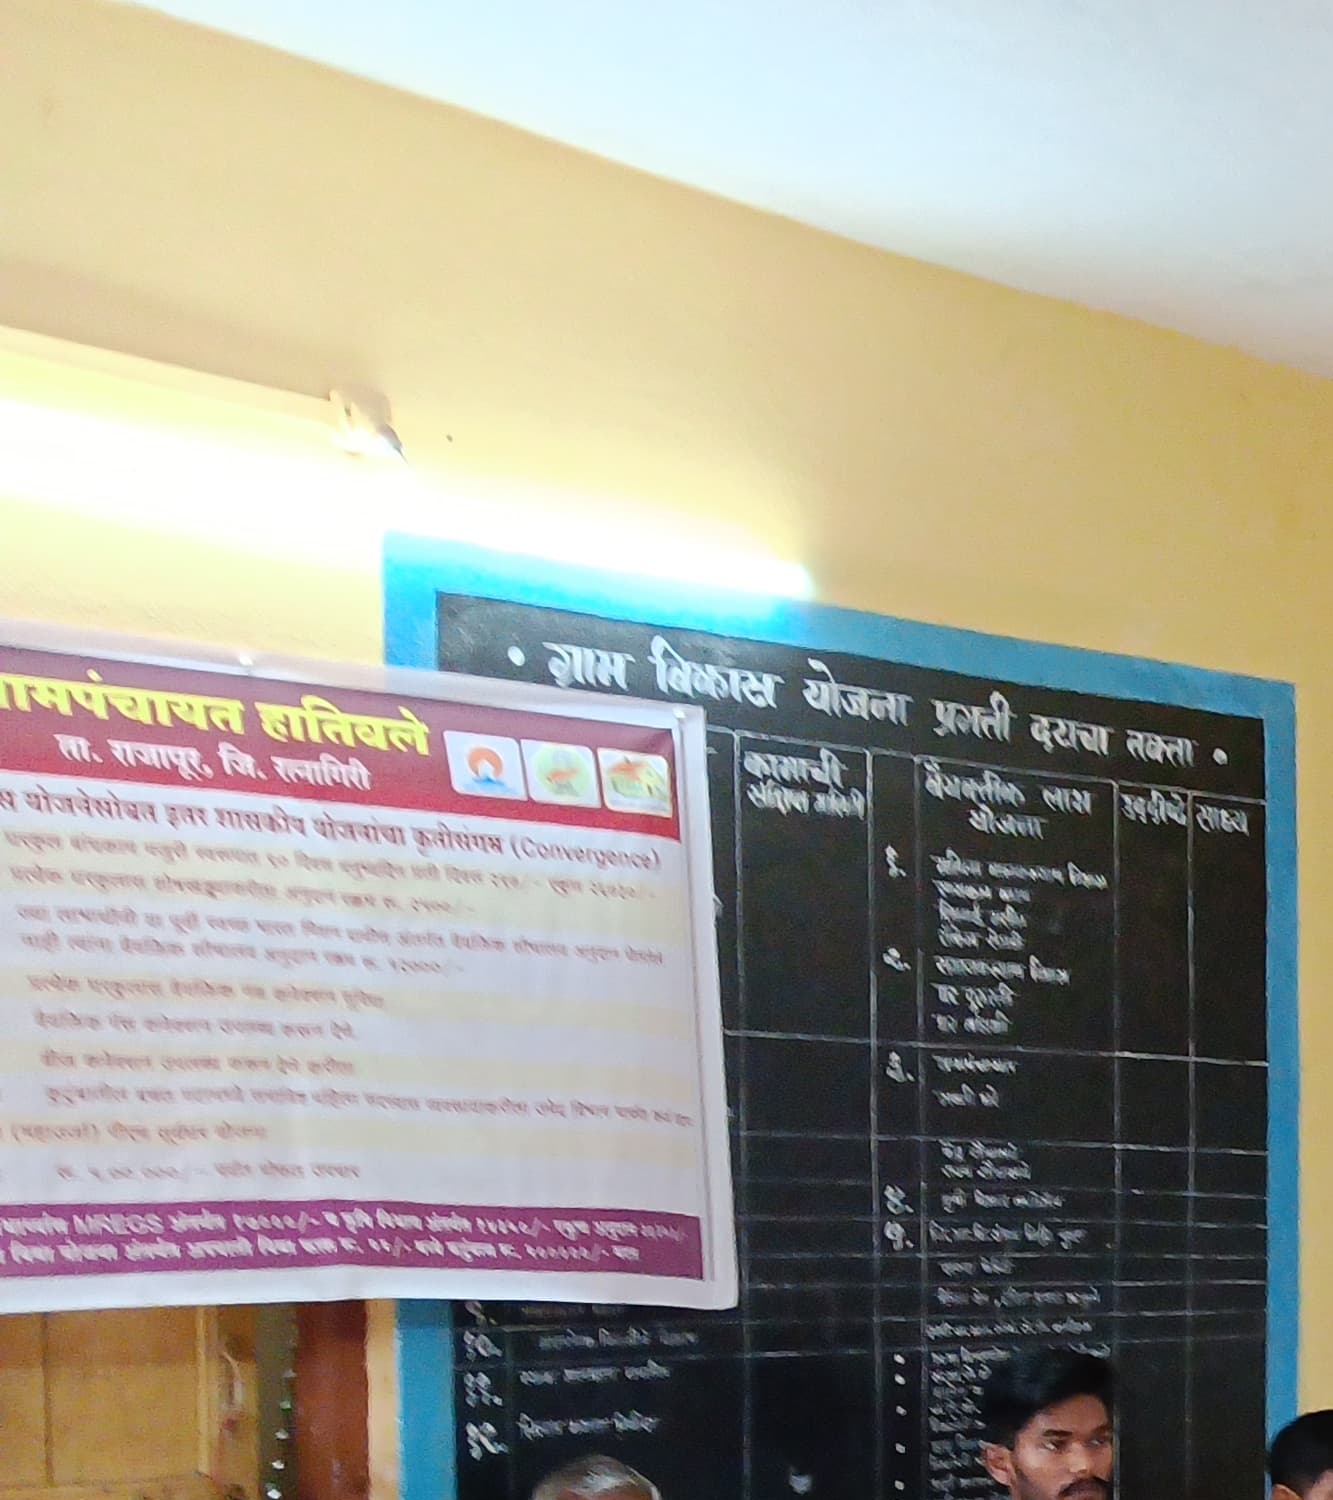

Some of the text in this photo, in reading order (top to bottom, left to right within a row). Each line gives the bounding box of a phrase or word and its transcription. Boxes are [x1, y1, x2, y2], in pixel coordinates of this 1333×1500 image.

[254, 694, 430, 756] हातिवले
[648, 634, 785, 709] विकास
[801, 657, 914, 727] योजना
[929, 690, 1018, 743] प्रगती
